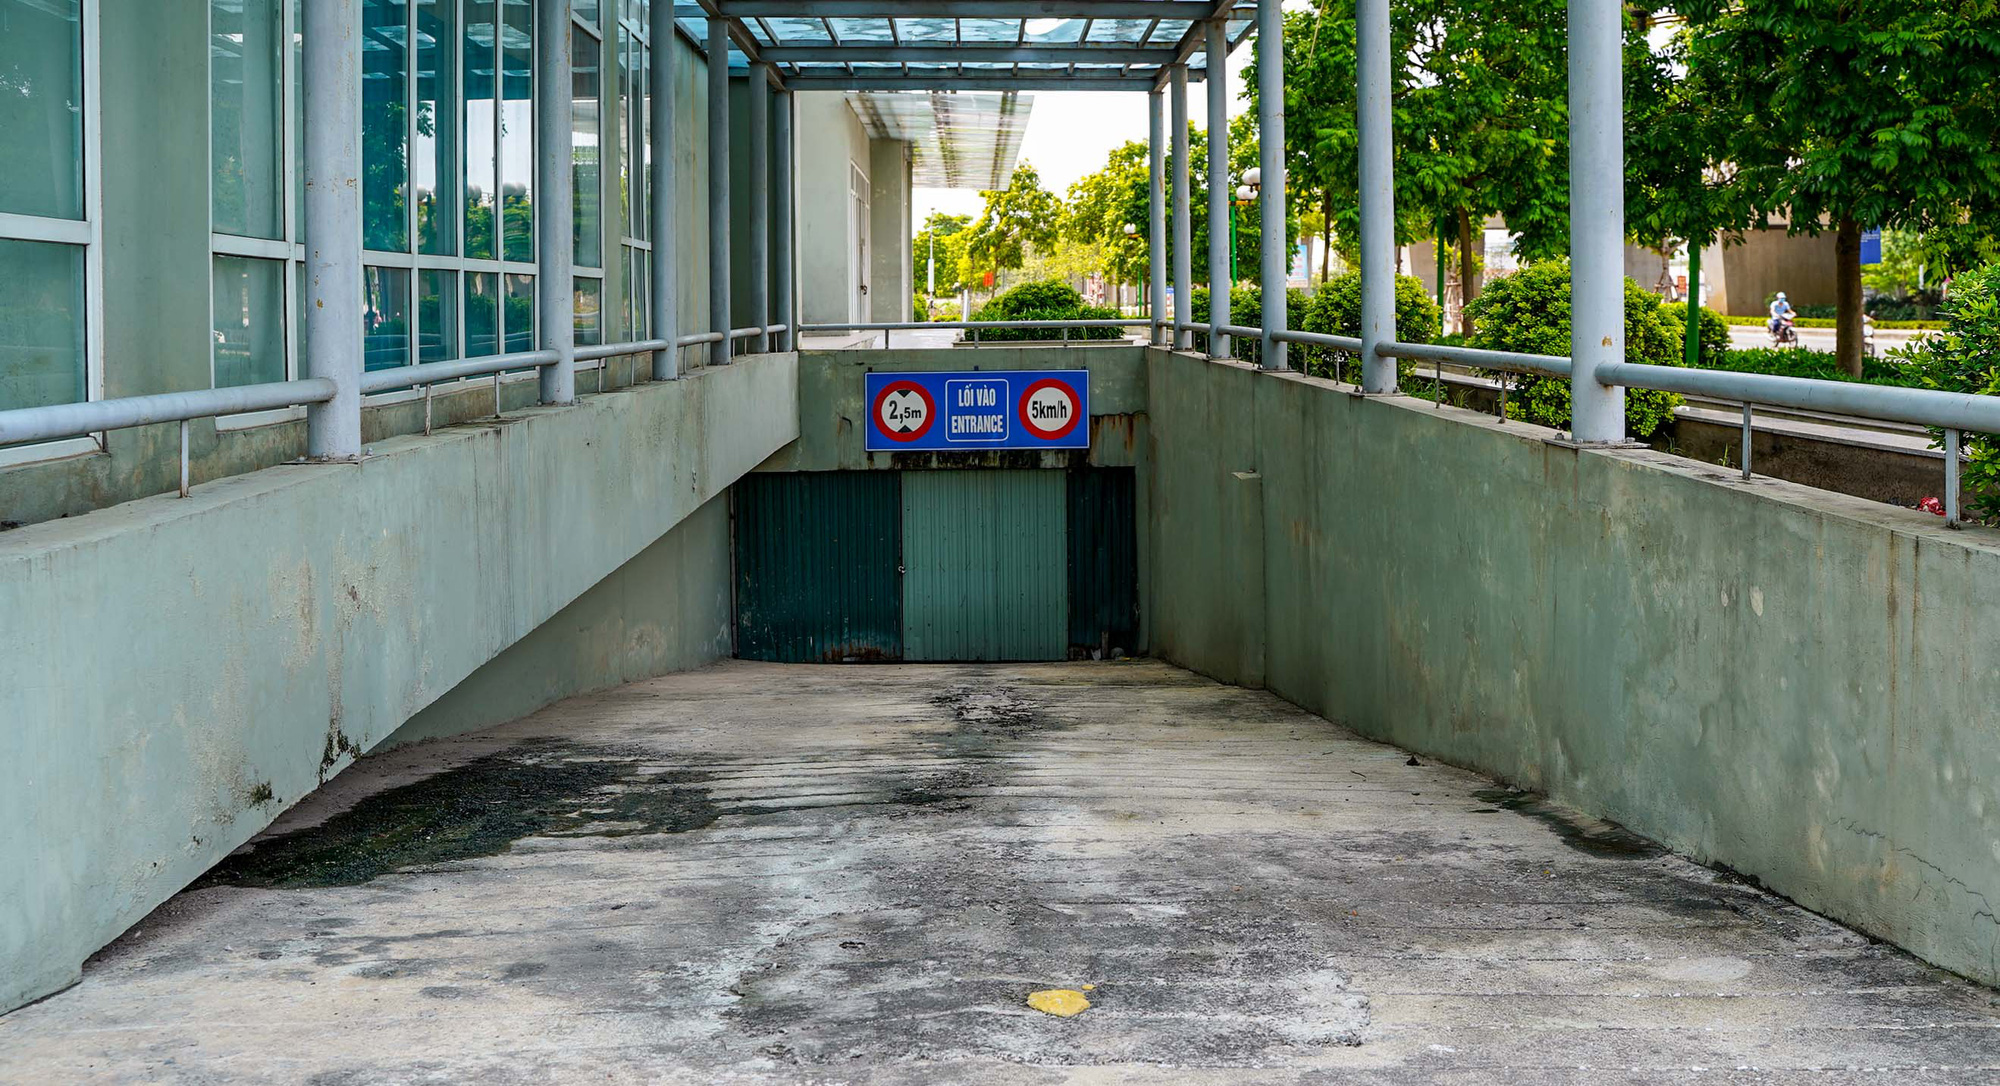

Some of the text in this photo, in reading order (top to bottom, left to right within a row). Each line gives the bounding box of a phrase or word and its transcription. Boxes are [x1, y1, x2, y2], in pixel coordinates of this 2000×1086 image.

[958, 384, 996, 407] LỐI VÀO
[889, 400, 922, 423] 2,5m
[1031, 400, 1067, 418] 5km/h
[951, 415, 1003, 434] ENTRANCE
